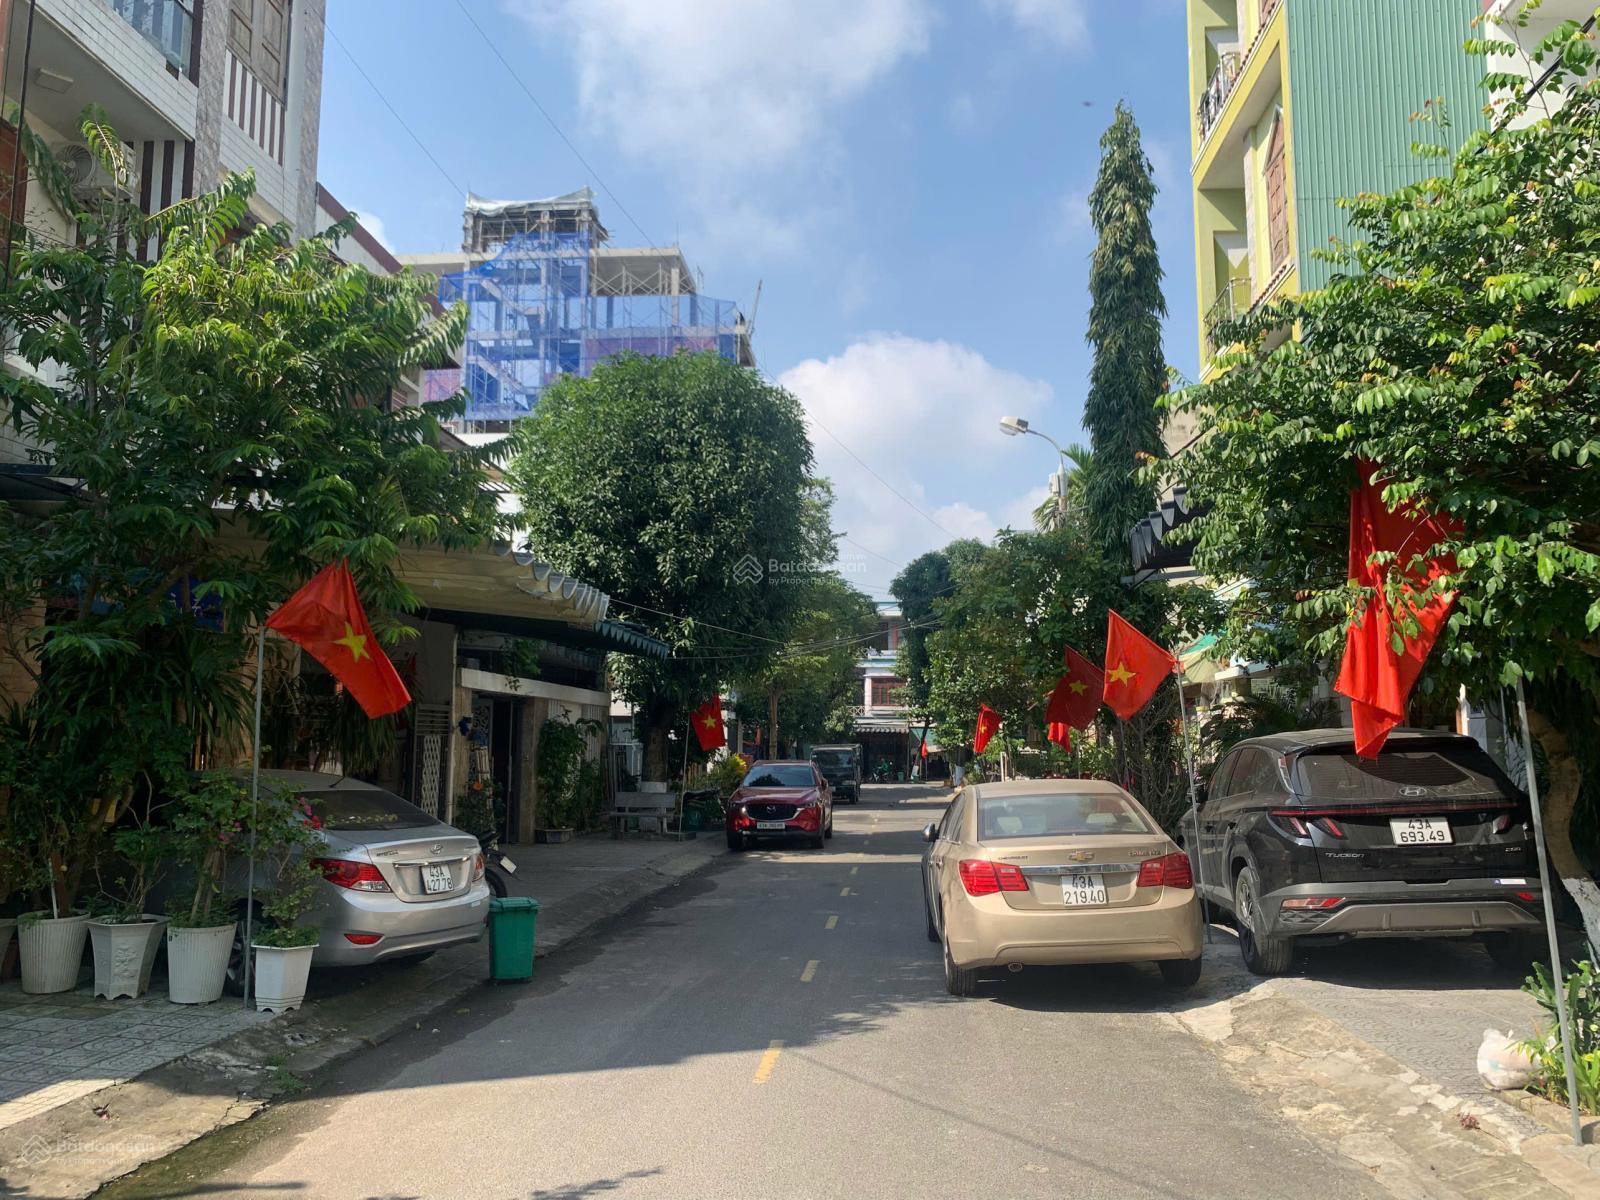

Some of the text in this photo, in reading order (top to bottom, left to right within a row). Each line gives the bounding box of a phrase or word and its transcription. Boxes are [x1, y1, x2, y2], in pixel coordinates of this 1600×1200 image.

[1408, 818, 1432, 830] 43A
[1400, 830, 1445, 842] 693.49
[430, 864, 445, 878] 43A
[1072, 873, 1095, 889] 43A
[1064, 889, 1105, 904] 219.40
